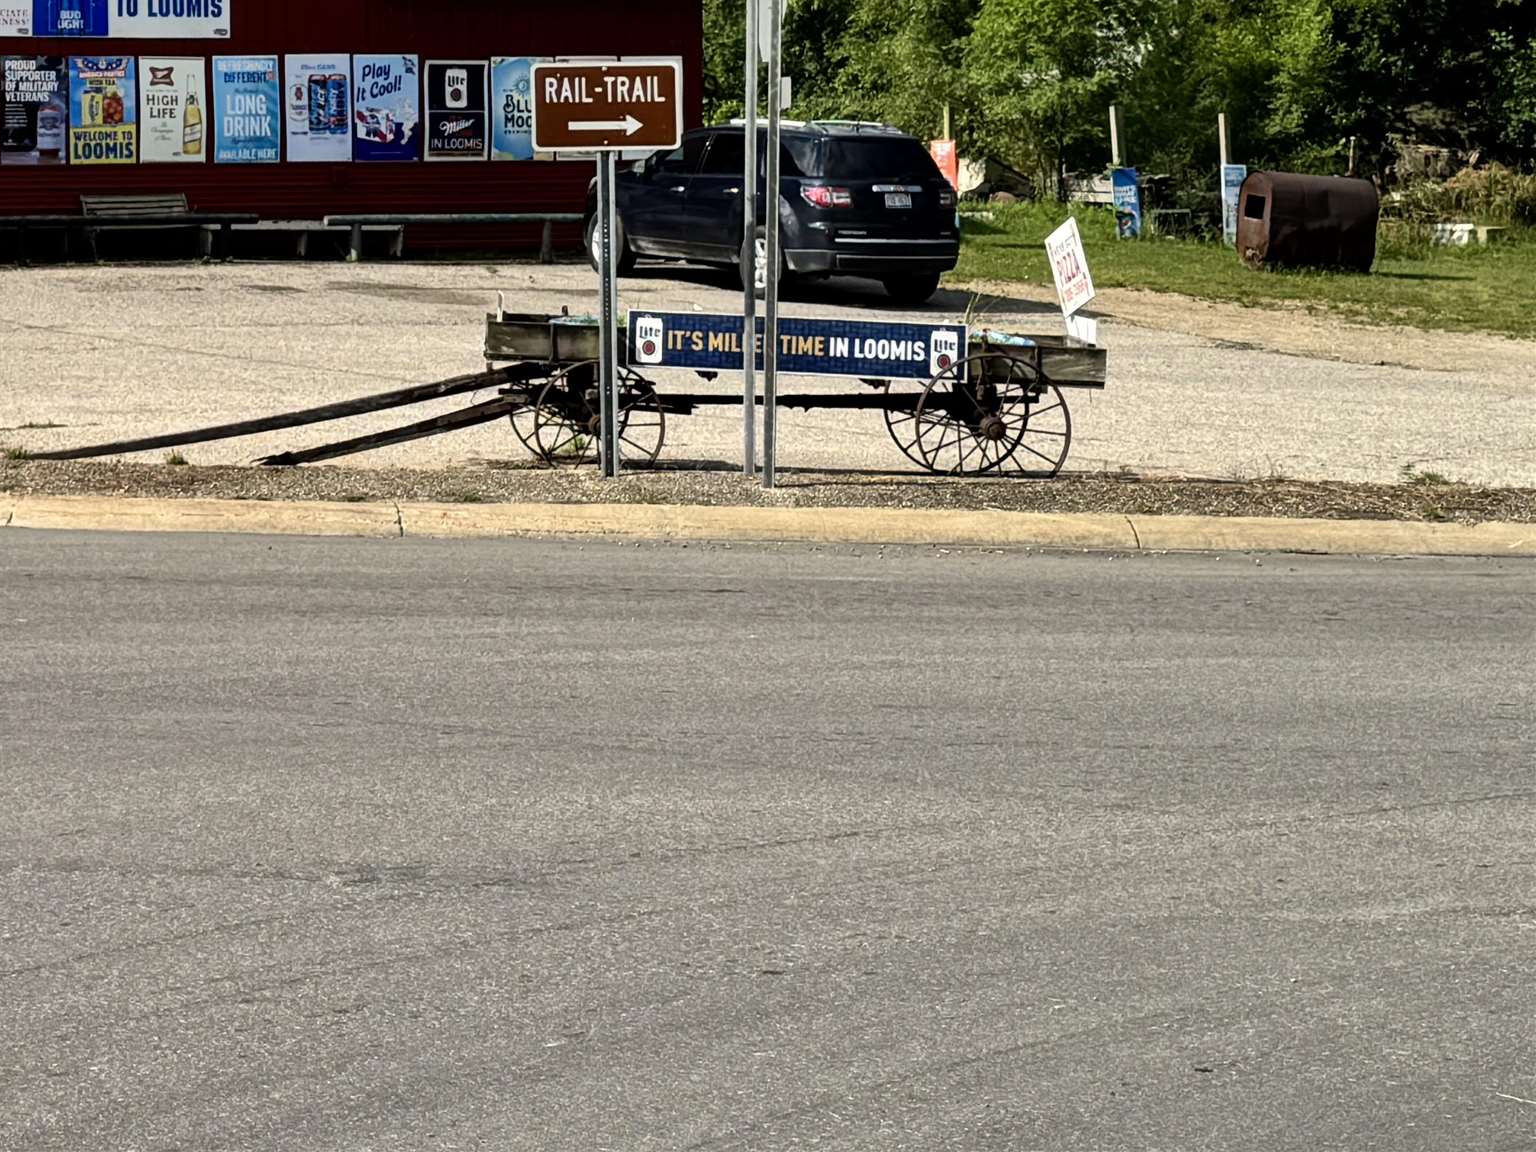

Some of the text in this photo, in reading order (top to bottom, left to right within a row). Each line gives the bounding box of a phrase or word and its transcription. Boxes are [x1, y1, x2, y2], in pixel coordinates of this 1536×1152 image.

[60, 10, 81, 19] BUD
[57, 19, 84, 29] LIGHT
[4, 59, 36, 71] PROUD
[362, 62, 391, 82] Play
[4, 70, 57, 81] SUPPORTER
[223, 71, 267, 83] DIFFERENT
[5, 81, 59, 92] OF MILITARY
[356, 75, 402, 103] It Cool!
[544, 76, 666, 104] RAIL-TRAIL
[4, 91, 49, 102] VETERANS
[146, 94, 179, 106] HIGH
[227, 94, 267, 115] LONG
[503, 94, 532, 114] BLU
[149, 107, 177, 119] LIFE
[223, 116, 272, 137] DRINK
[439, 118, 476, 137] Miller
[504, 114, 532, 128] MOO
[73, 131, 133, 141] WELCOME TO
[431, 138, 483, 149] IN LOOMIS
[74, 142, 134, 160] LOOMIS
[639, 325, 661, 339] Lite
[667, 330, 925, 361] IT'S MILE TIME IN LOOMIS
[934, 338, 956, 353] Lite
